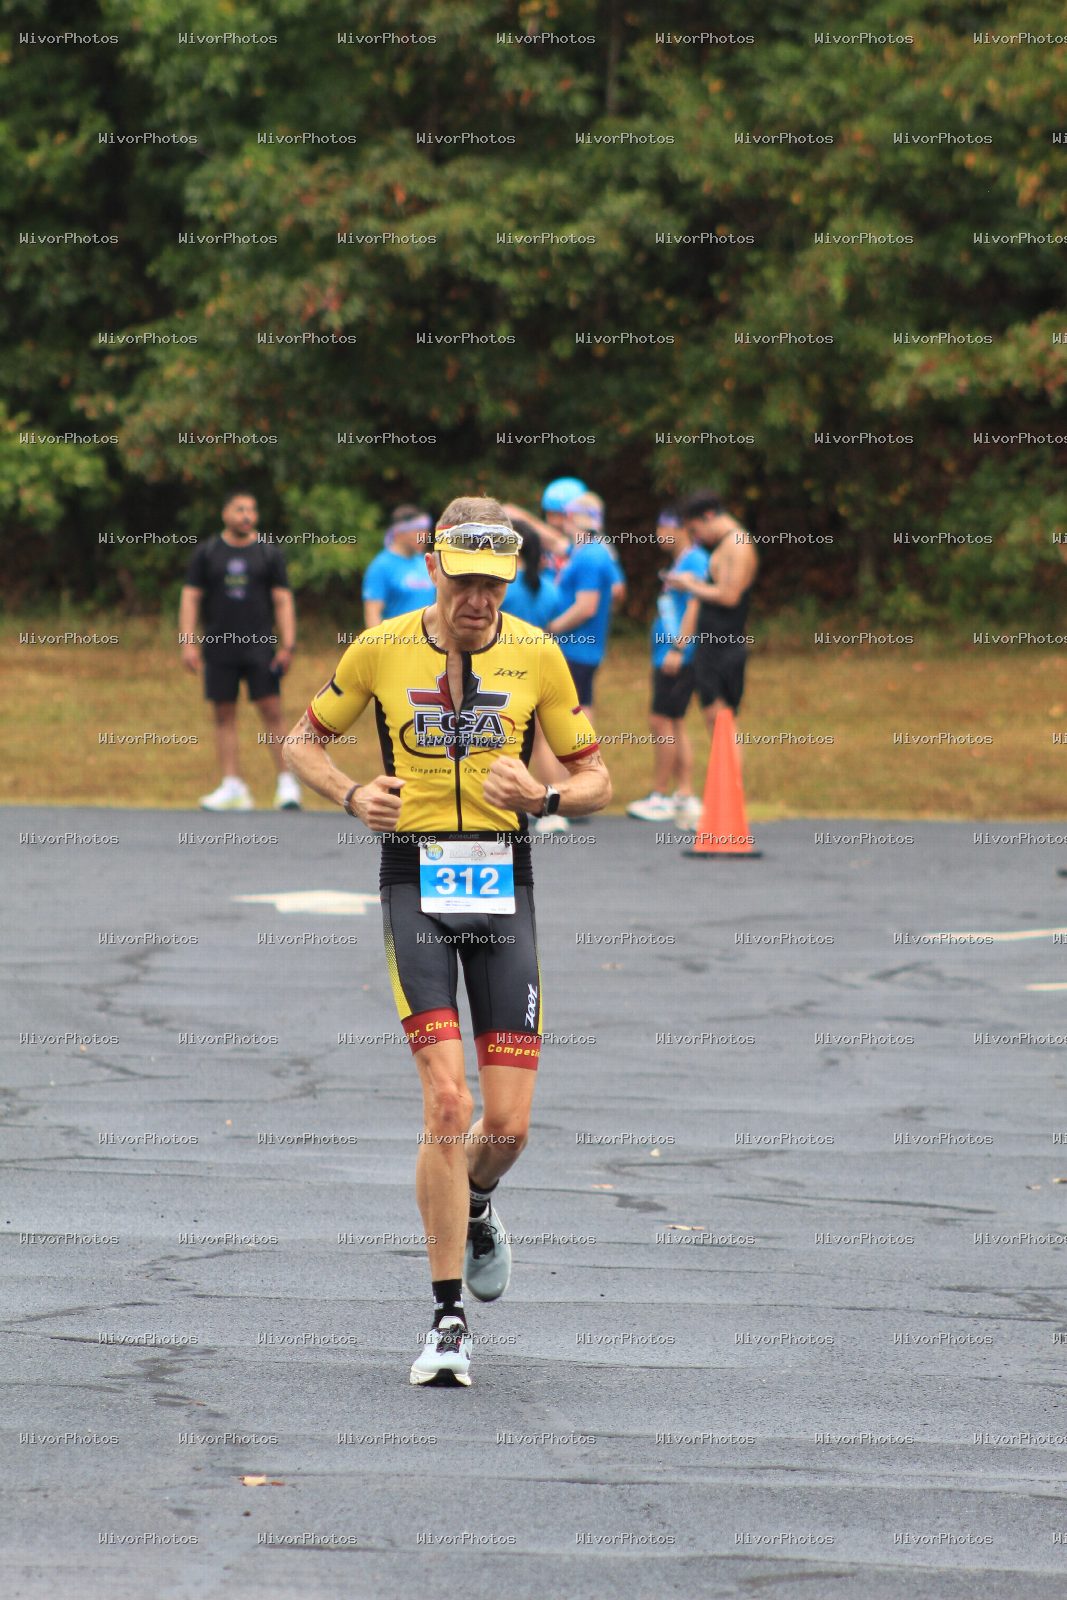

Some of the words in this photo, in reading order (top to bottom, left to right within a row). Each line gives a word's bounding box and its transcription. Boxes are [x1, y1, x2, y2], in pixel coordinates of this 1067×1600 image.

[414, 711, 505, 736] FCA
[411, 766, 452, 774] Competing
[435, 867, 499, 895] 312
[425, 1019, 459, 1032] Chris
